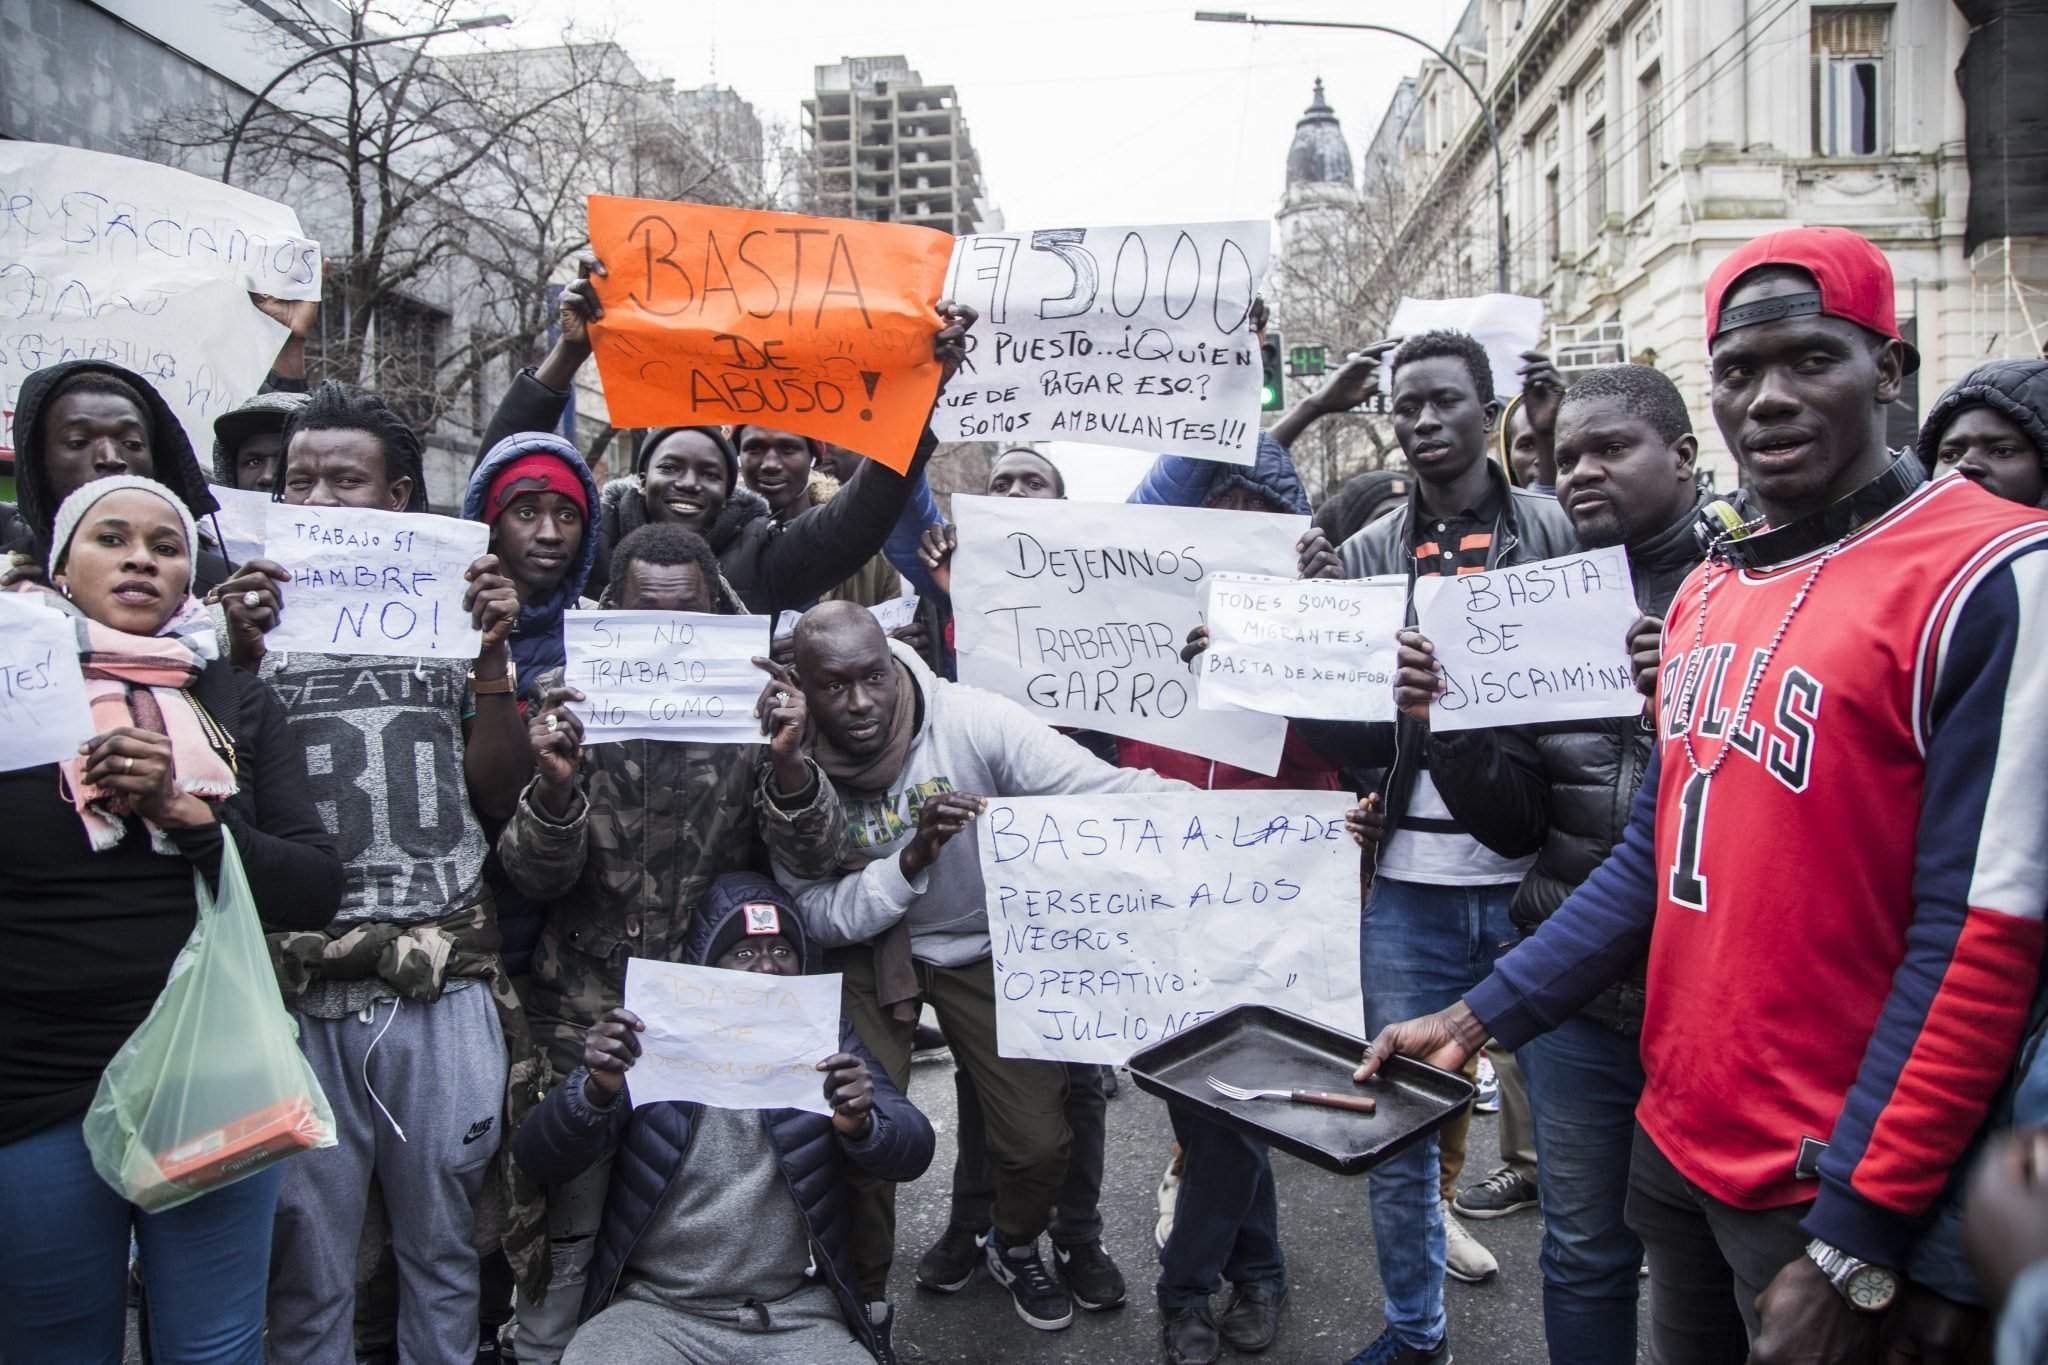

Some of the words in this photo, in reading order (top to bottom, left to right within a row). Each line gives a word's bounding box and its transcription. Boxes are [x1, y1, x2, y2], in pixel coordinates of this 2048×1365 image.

[627, 215, 873, 331] BASTA
[713, 334, 800, 371] DE
[1039, 368, 1125, 397] PAGAR
[1050, 411, 1248, 450] AMBULANTES!!!
[294, 523, 381, 548] TRABAJO
[1006, 531, 1205, 594] DEJENNOS
[1216, 591, 1282, 612] TODES
[1296, 592, 1362, 617] SOMOS
[1457, 558, 1602, 613] BASTA
[331, 600, 440, 649] NO!
[653, 619, 695, 645] NO
[983, 605, 1180, 669] TRABAJAR
[1465, 616, 1523, 655] DE
[583, 658, 706, 688] TRABAJO
[1208, 653, 1274, 677] BASTA
[1283, 664, 1305, 680] DE
[589, 699, 626, 726] NO
[1661, 642, 1823, 794] BULLS
[990, 806, 1164, 864] BASTA
[1668, 771, 1708, 913] 1
